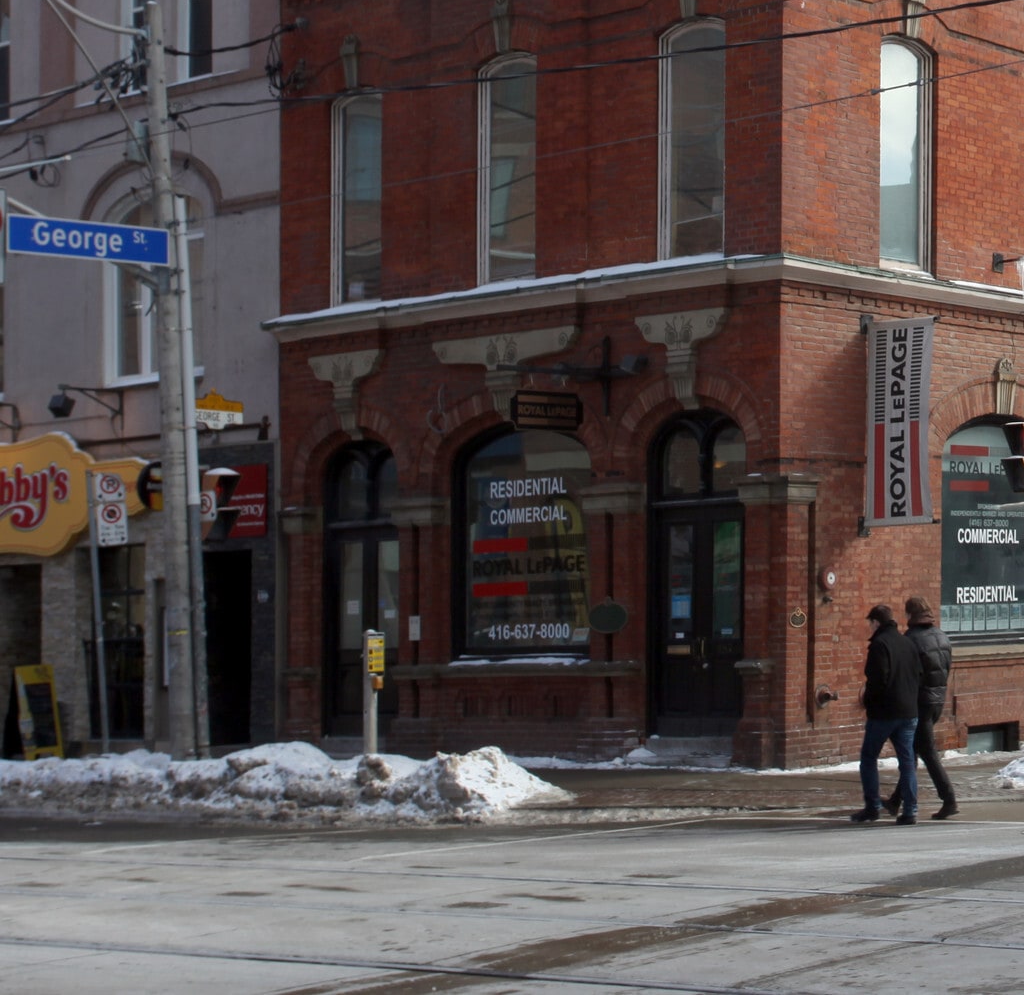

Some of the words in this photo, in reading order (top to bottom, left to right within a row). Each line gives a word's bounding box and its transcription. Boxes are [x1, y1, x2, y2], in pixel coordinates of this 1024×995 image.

[32, 221, 123, 257] George
[196, 411, 220, 421] EORGE
[518, 404, 545, 416] ROYAL
[889, 429, 907, 518] ROYAL
[949, 460, 984, 474] ROYAL
[490, 477, 567, 499] RESIDENTIAL
[490, 505, 567, 525] COMMERCIAL
[957, 528, 1020, 544] COMMERCIAL
[472, 558, 523, 577] ROYAL
[956, 585, 1019, 604] RESIDENTIAL
[488, 623, 570, 640] 416-637-8000
